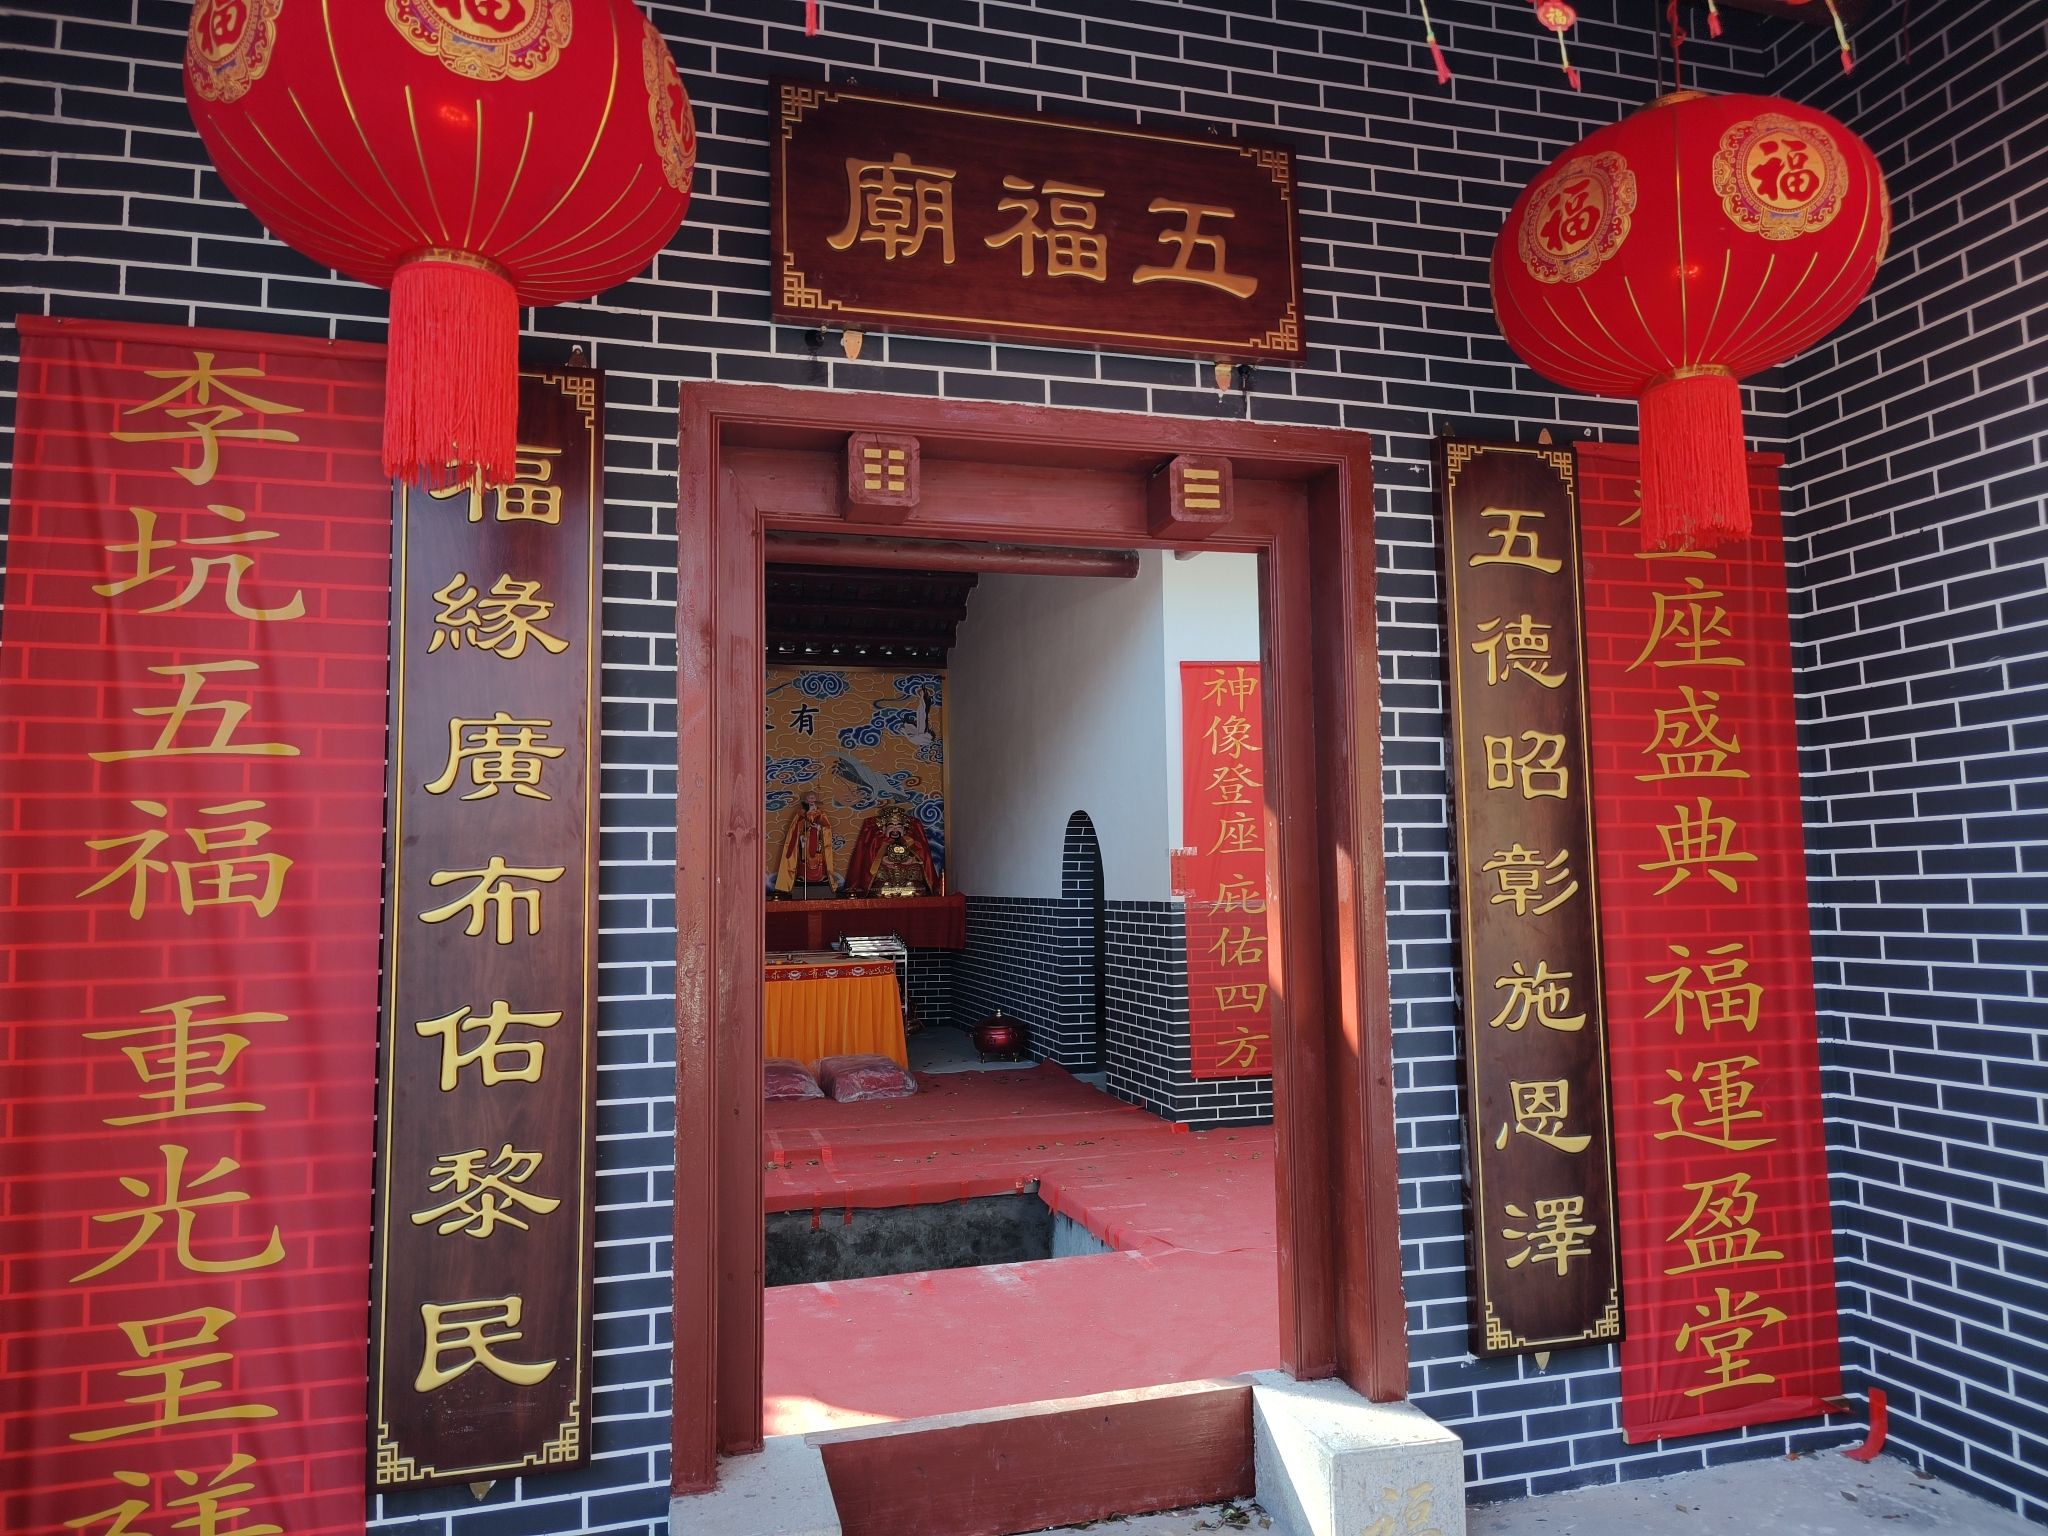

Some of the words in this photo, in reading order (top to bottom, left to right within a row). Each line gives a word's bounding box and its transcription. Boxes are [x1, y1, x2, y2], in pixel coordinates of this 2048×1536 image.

[1540, 178, 1601, 252] 福
[1750, 139, 1820, 202] 福
[1201, 666, 1270, 1069] 神像登座庇佑四方
[1468, 506, 1597, 1277] 五德昭彰施恩澤
[1617, 476, 1788, 1398] 座盛典福運盈堂
